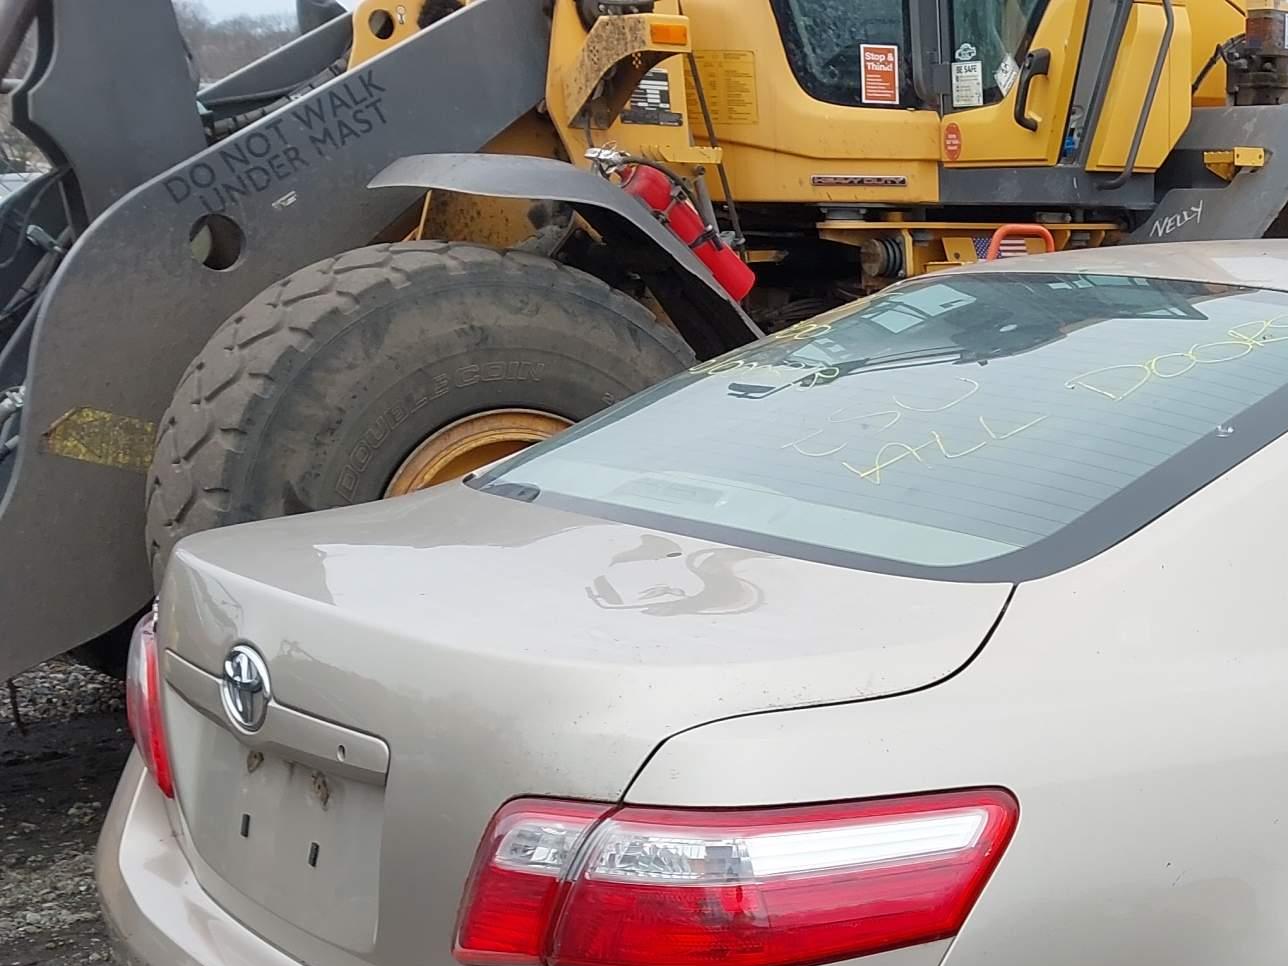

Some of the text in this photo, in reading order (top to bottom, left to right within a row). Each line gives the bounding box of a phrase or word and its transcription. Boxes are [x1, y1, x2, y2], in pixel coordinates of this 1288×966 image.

[865, 52, 894, 61] Stop &
[956, 65, 978, 73] BE SAFE
[163, 70, 386, 203] DO NOT WALK
[199, 97, 387, 213] UNDER MAST
[1149, 200, 1203, 237] NELLY
[336, 361, 545, 502] DOUBLE COIN
[842, 412, 1048, 485] ALL
